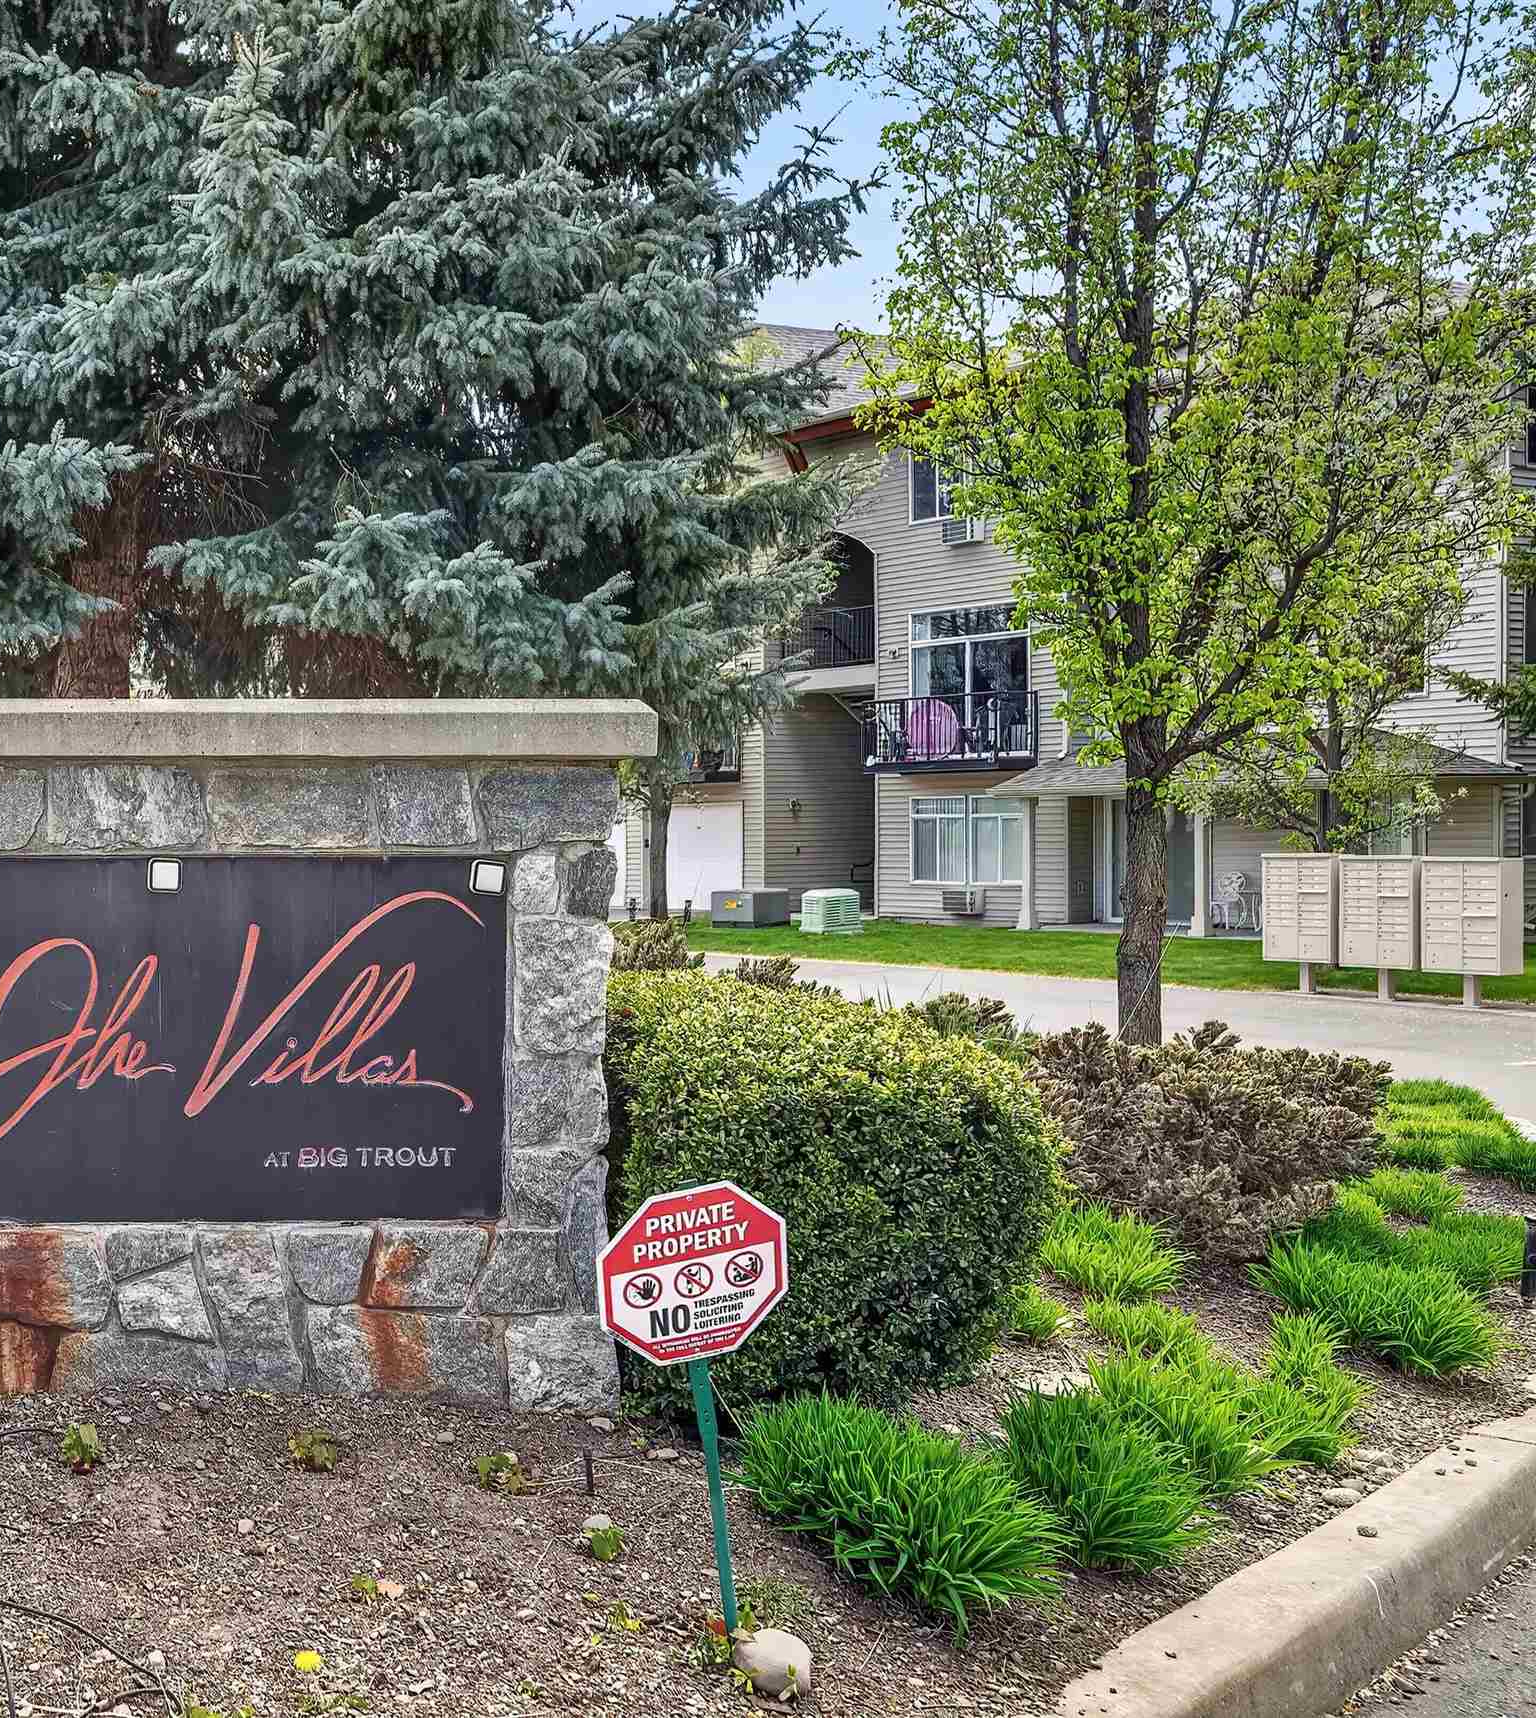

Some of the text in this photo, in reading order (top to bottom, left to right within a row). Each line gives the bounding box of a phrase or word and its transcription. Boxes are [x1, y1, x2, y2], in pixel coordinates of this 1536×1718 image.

[184, 890, 485, 1117] Villas
[264, 1147, 457, 1168] AT BIG TROUT
[645, 1200, 736, 1237] PRIVATE
[632, 1220, 749, 1264] PROPERTY
[650, 1304, 691, 1339] NO
[694, 1288, 755, 1309] TRESPASSING
[693, 1302, 744, 1320] SOLICITING
[694, 1313, 741, 1330] LOITERING
